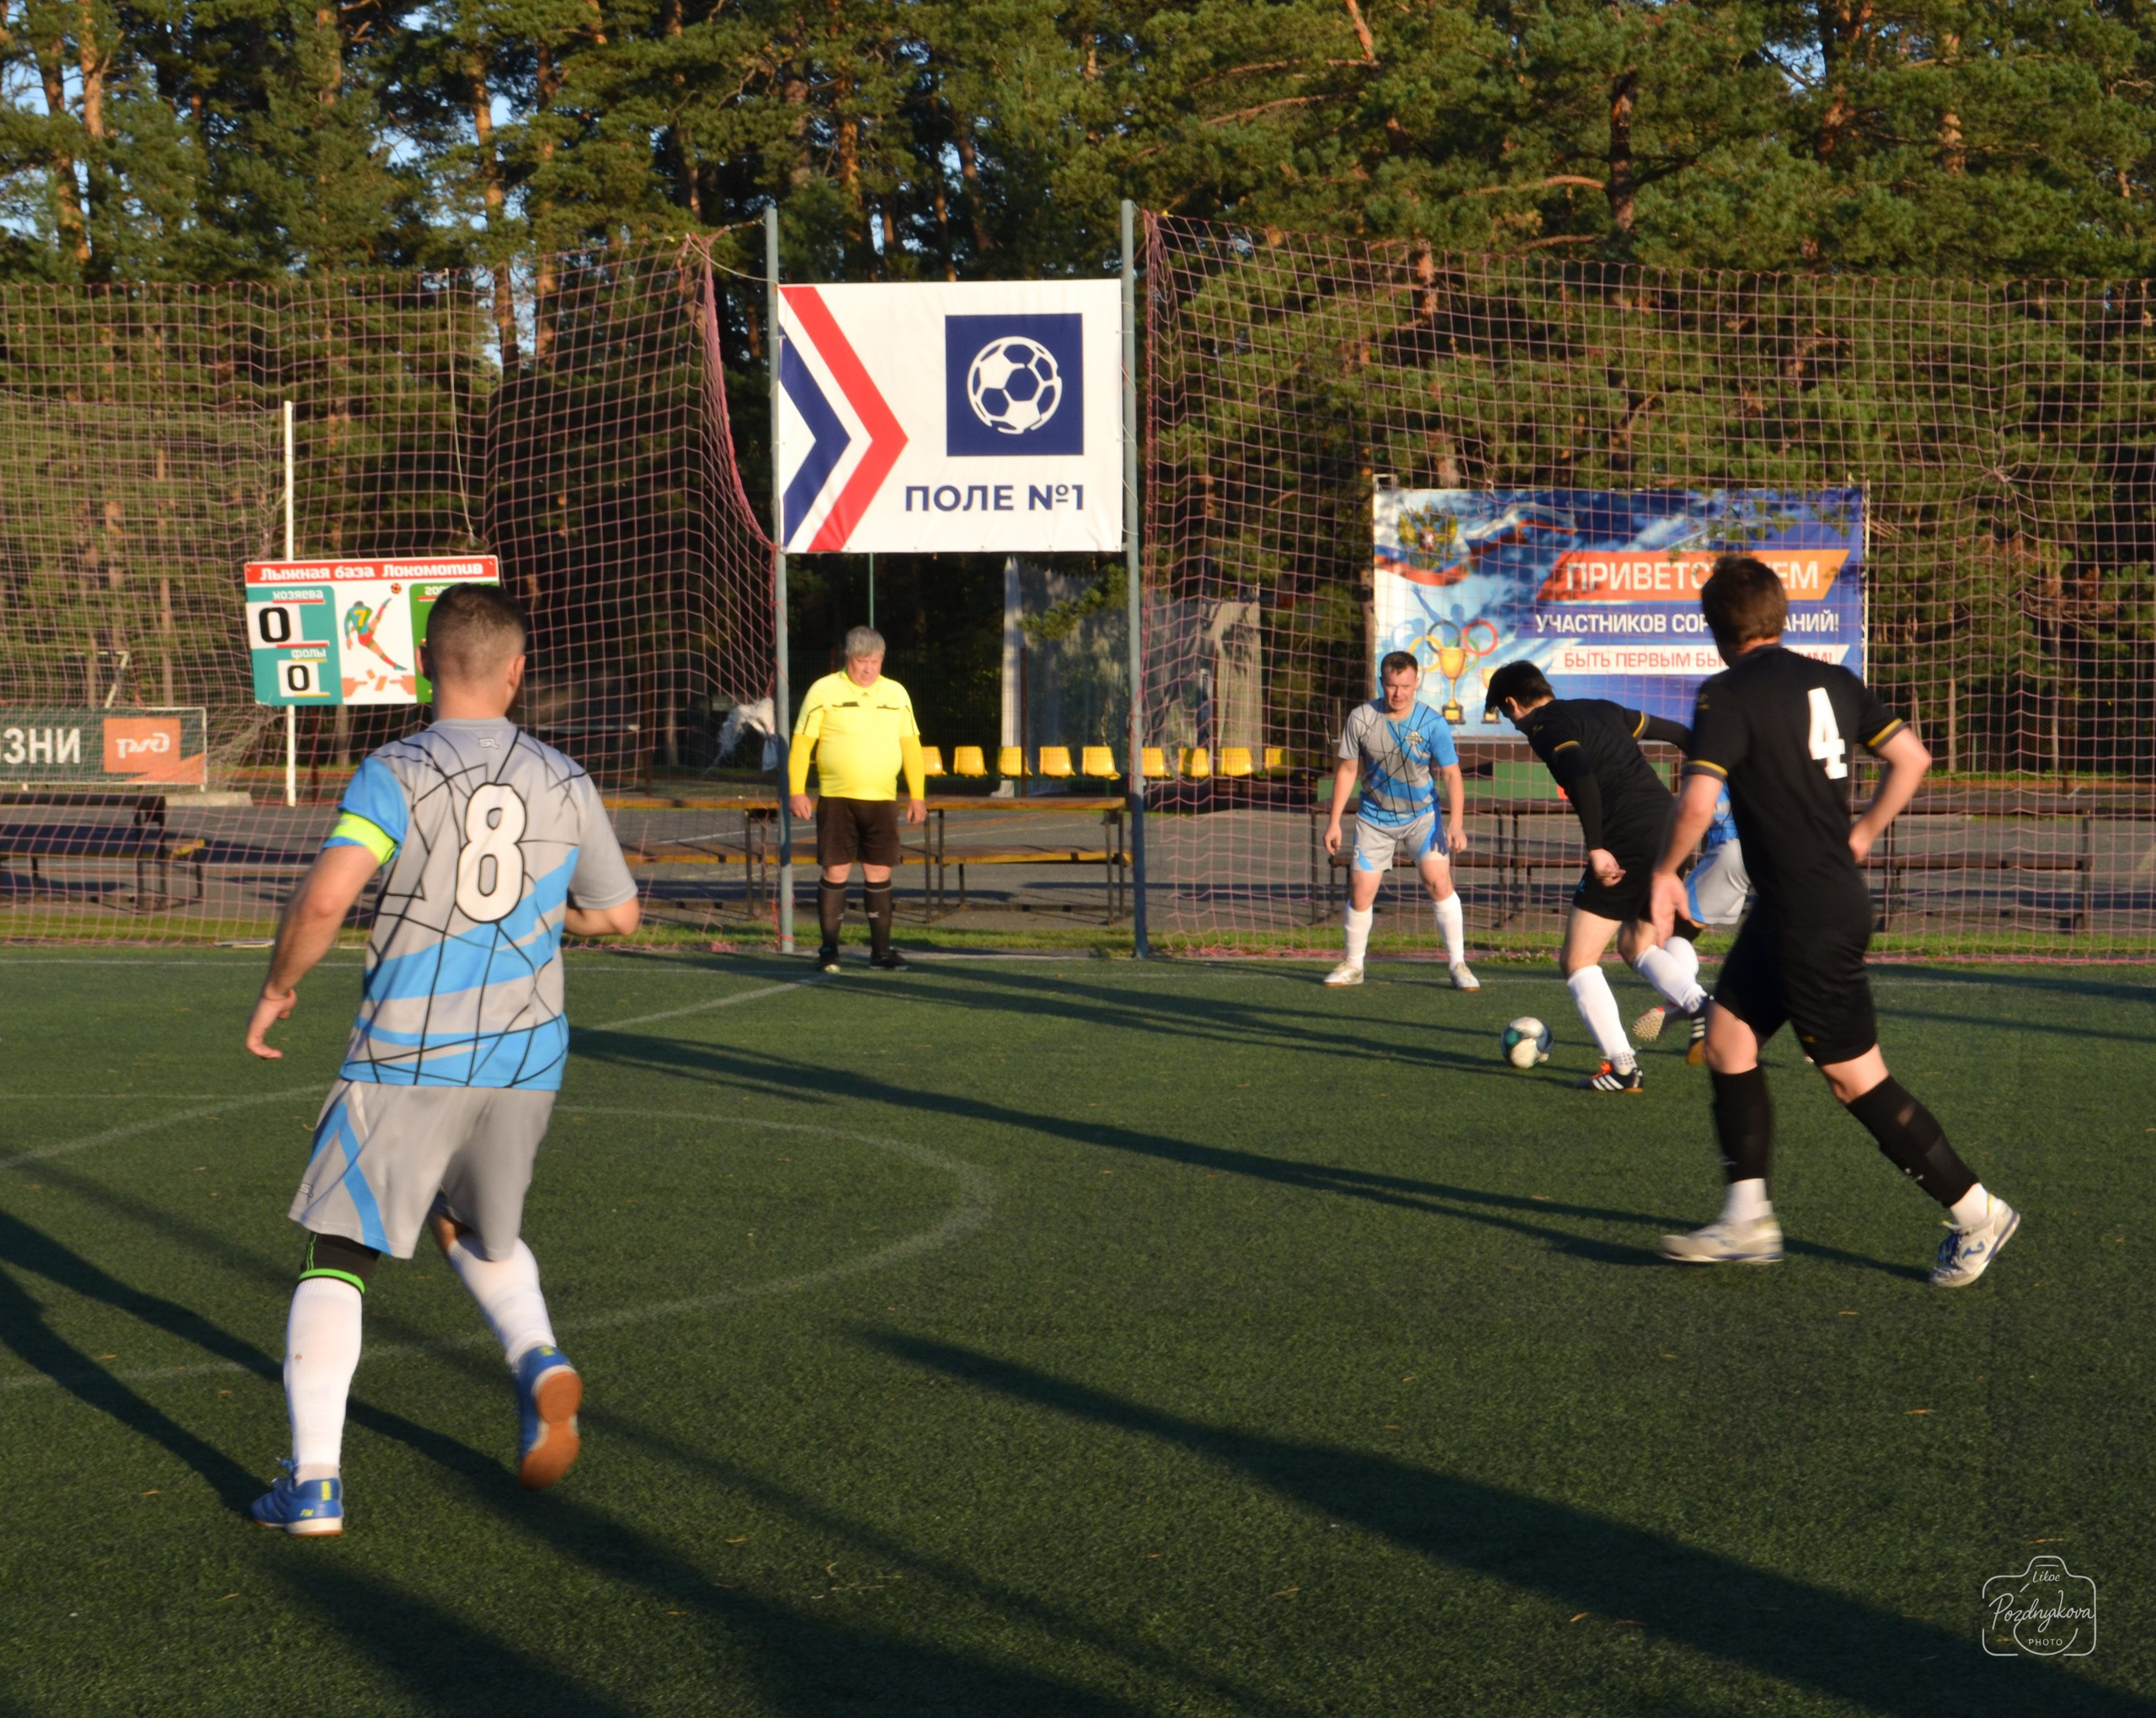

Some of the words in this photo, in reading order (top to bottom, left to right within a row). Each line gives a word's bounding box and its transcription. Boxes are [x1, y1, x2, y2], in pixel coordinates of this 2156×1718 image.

[905, 485, 1014, 512] ПОЛЕ
[1028, 484, 1084, 510] №1
[260, 566, 330, 581] Лыжная
[334, 565, 375, 578] база
[382, 563, 484, 579] Локомотив
[1566, 561, 1818, 590] ПРИВЕТСЕМ
[273, 590, 324, 600] хозяева
[259, 606, 291, 643] 0
[1535, 613, 1668, 633] УЧАСТНИКОВ
[291, 648, 327, 660] фолы
[1564, 652, 1610, 668] БЫТЬ
[1615, 652, 1691, 668] ПЕРВЫМ
[287, 664, 311, 691] 0
[3, 727, 81, 765] ЗНИ
[1807, 687, 1848, 779] 4
[456, 782, 527, 923] 8
